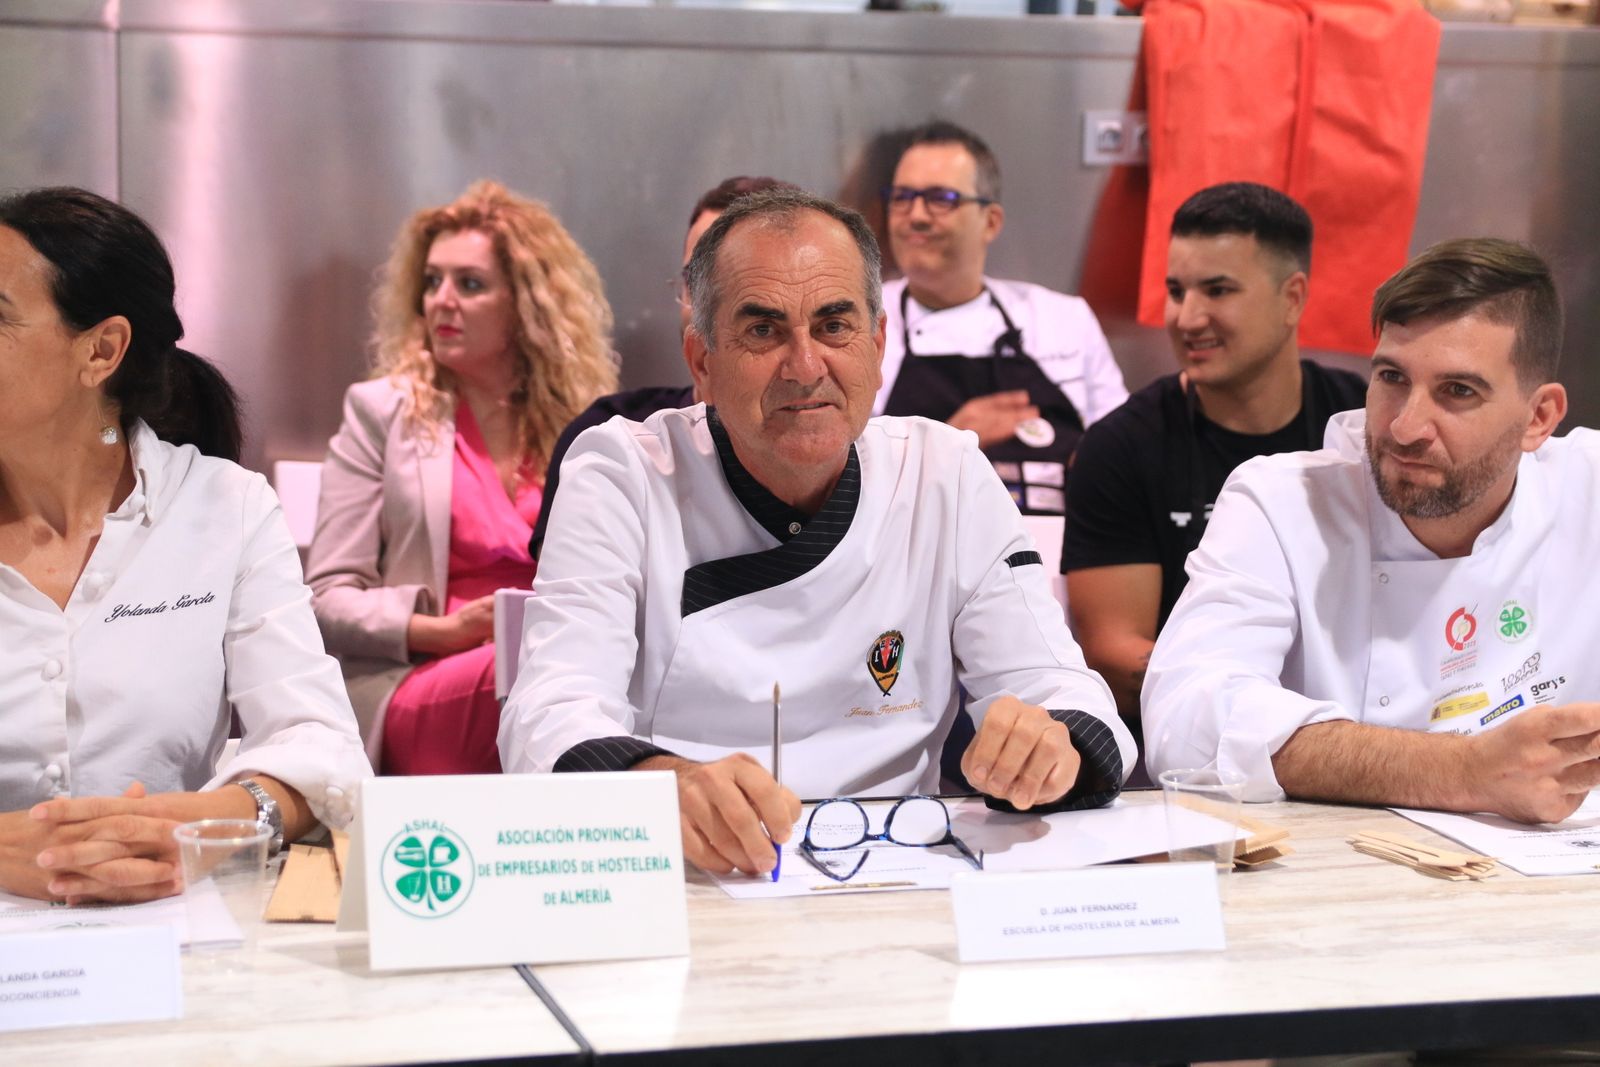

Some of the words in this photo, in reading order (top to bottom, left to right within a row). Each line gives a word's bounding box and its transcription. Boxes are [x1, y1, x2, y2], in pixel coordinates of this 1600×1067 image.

[104, 601, 167, 623] Yolanda
[1530, 675, 1566, 696] gary's
[1483, 699, 1521, 724] makro
[403, 819, 448, 833] ASHAL
[497, 825, 574, 845] ASOCIACIÓN
[578, 826, 650, 843] PROVINCIAL
[478, 865, 492, 877] DE
[495, 859, 580, 876] EMPRESARIOS
[581, 860, 594, 873] DE
[598, 853, 672, 873] HOSTELERÍA
[544, 892, 557, 905] DE
[559, 888, 612, 905] ALMERÍA
[1052, 906, 1077, 915] JUAN
[1081, 902, 1139, 913] FERNANDEZ
[1003, 926, 1047, 936] ESCUELA
[1049, 924, 1061, 933] DE
[1124, 919, 1136, 928] DE
